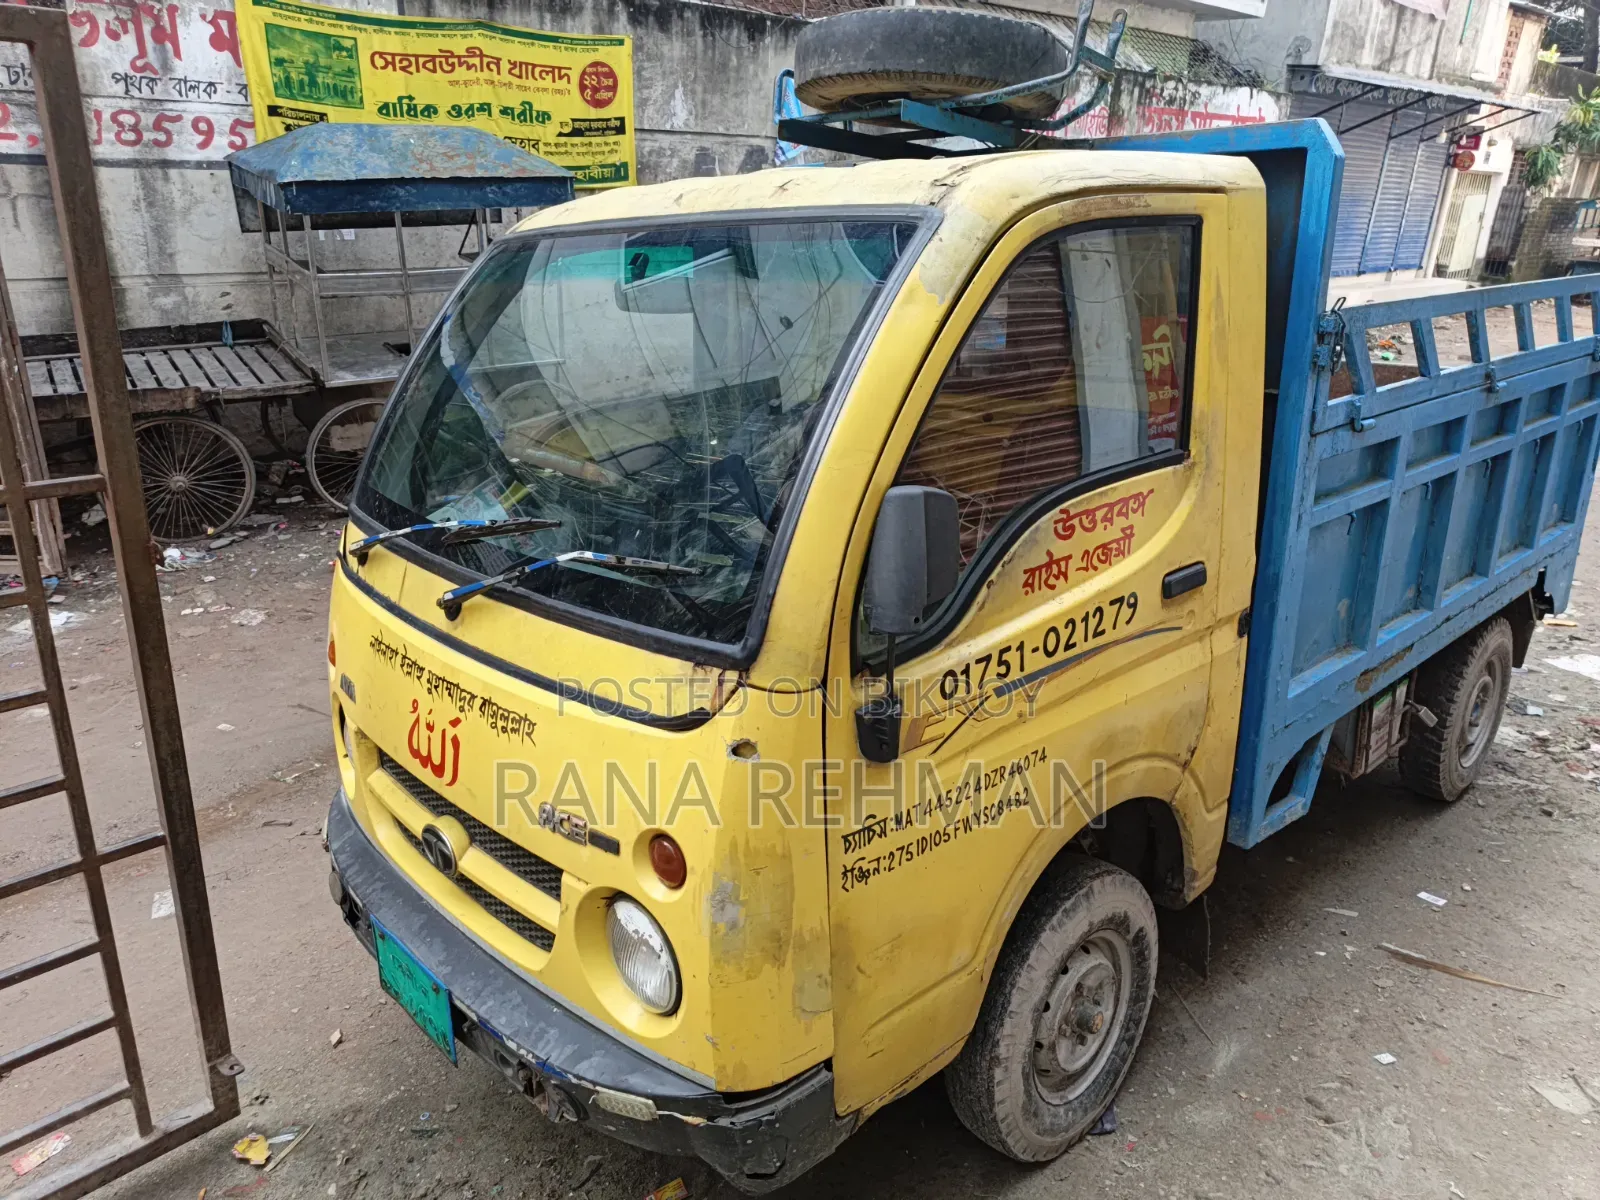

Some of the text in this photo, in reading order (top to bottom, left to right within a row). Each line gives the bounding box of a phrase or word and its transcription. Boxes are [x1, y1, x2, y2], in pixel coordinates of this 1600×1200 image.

[370, 46, 572, 85] সেহাবউদ্দীন খালেদ
[583, 75, 600, 88] ২২
[169, 75, 223, 99] বালক
[584, 89, 591, 100] ৫
[377, 94, 552, 125] বার্ষিক ওরশ শরীফ
[1053, 488, 1155, 541] উত্তরবঙ্গ
[1022, 549, 1072, 596] রাইস
[939, 591, 1139, 701] 01751-021279
